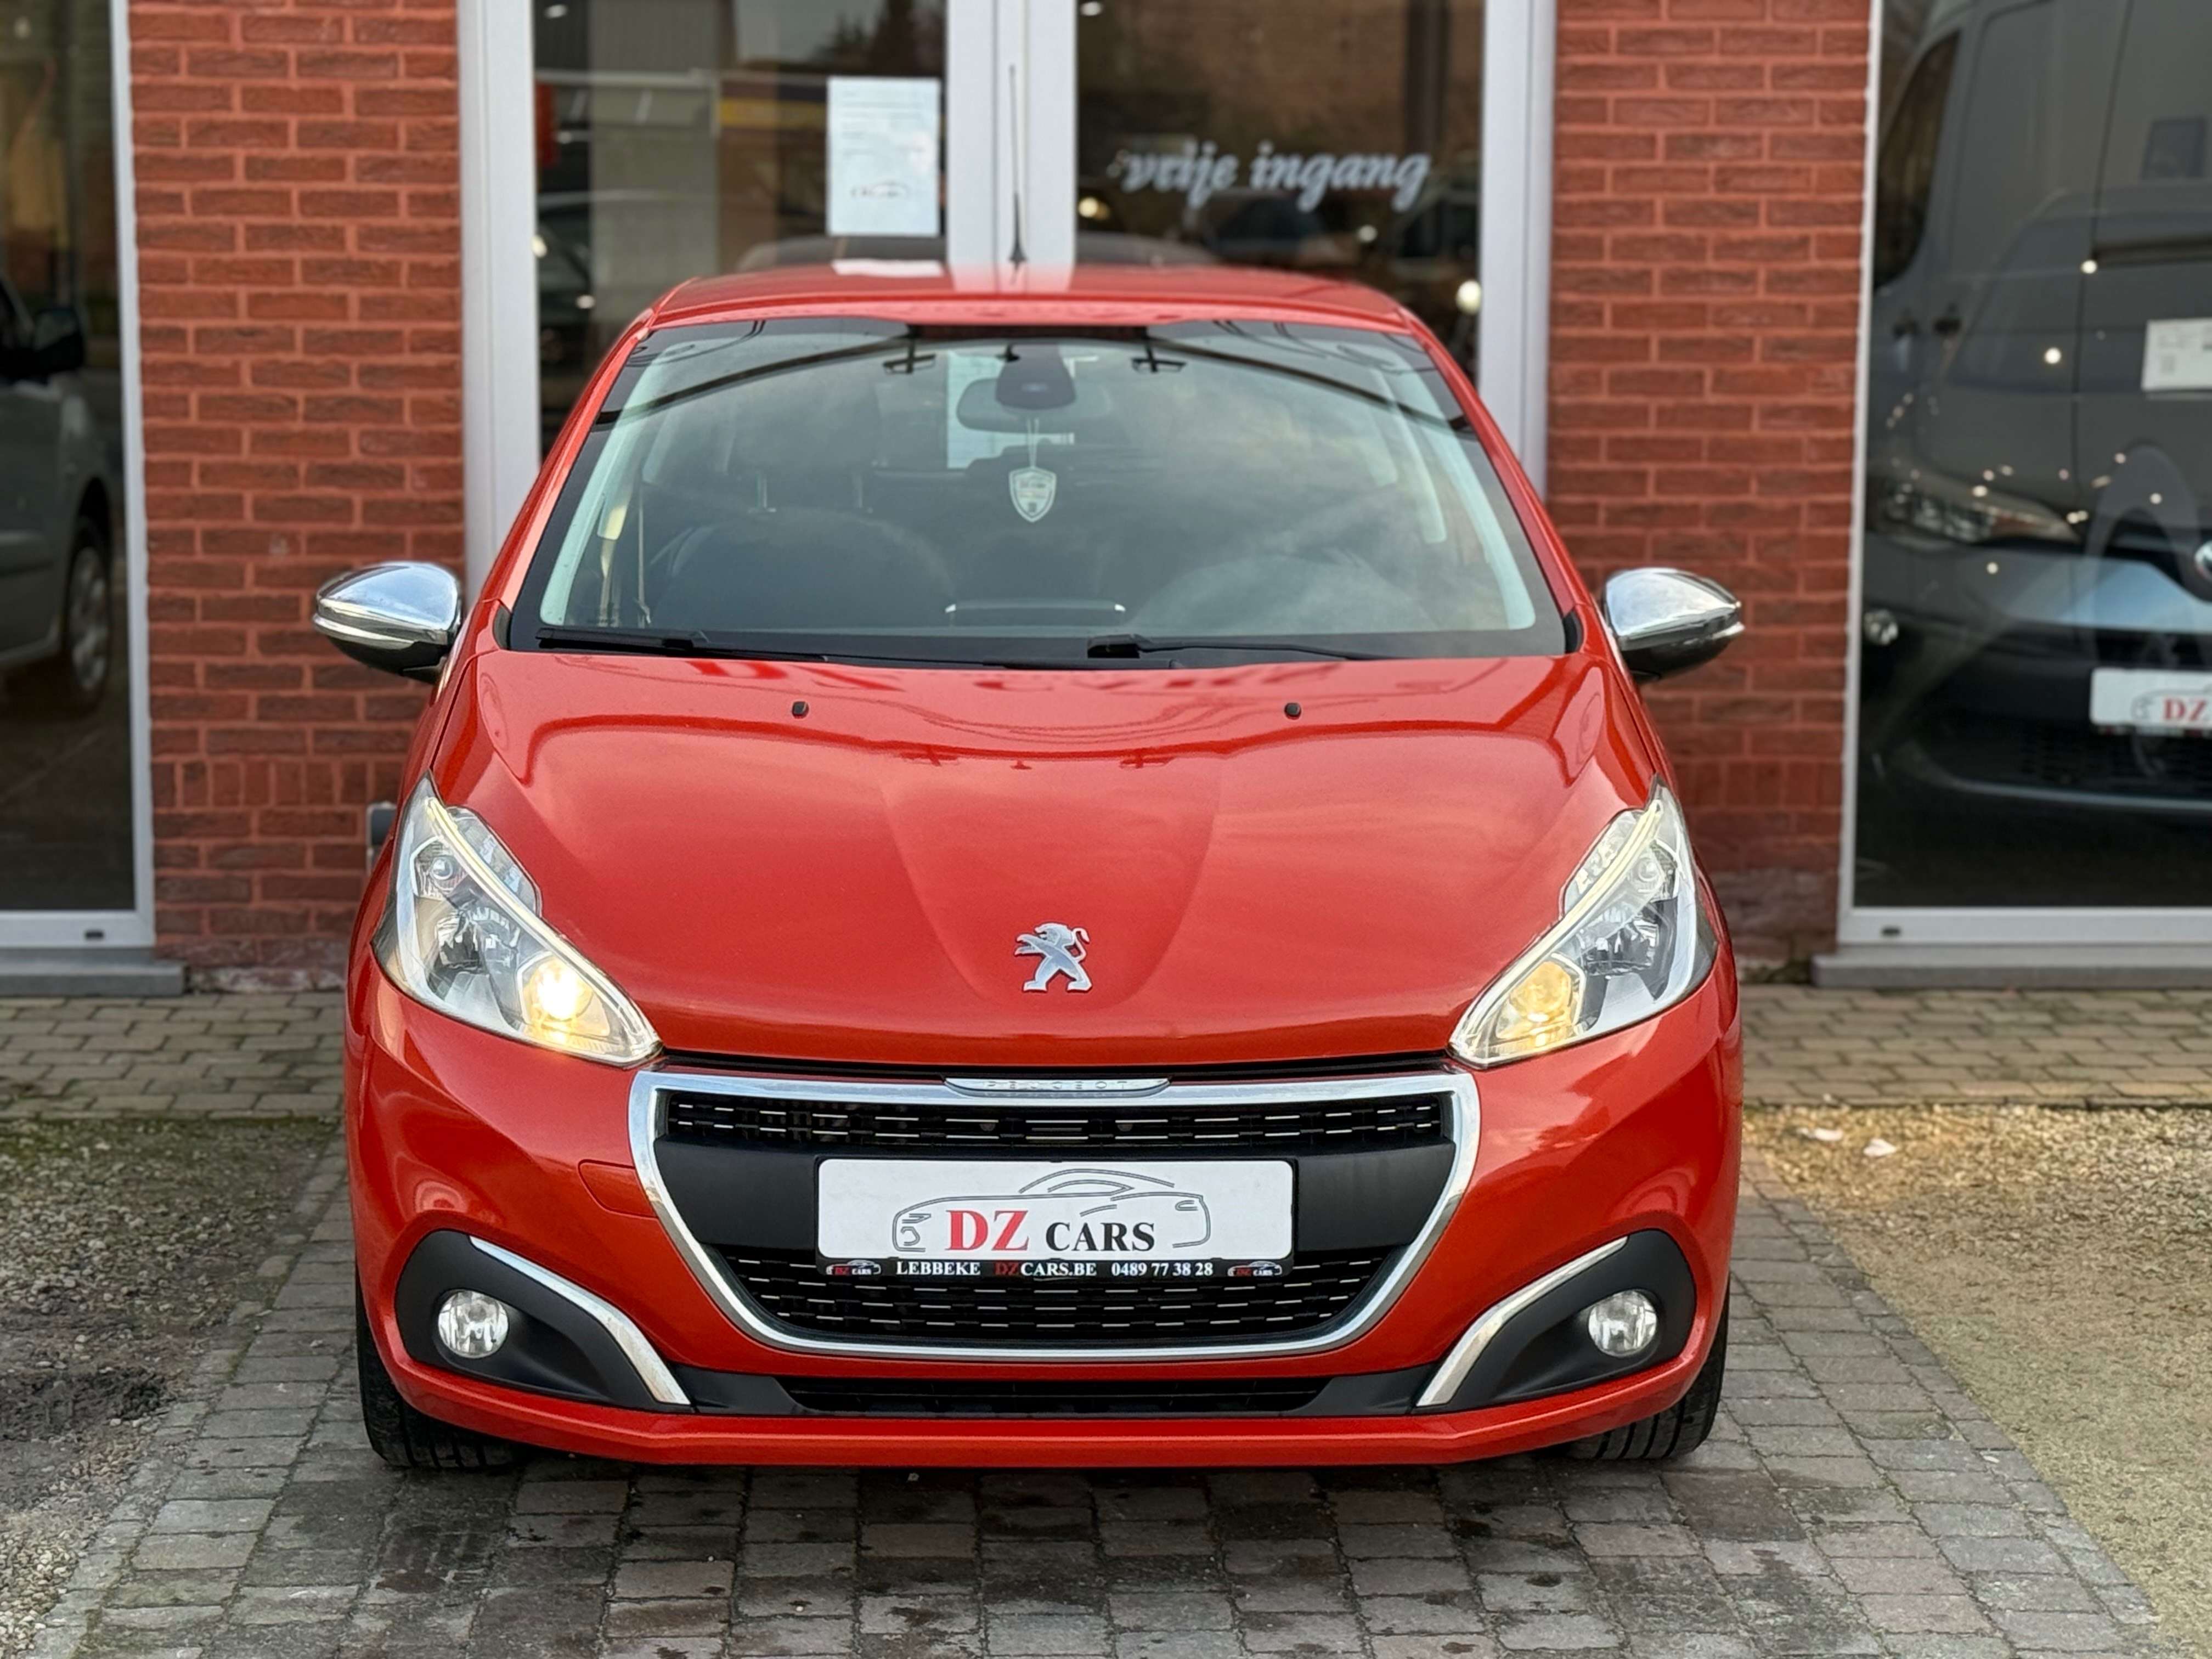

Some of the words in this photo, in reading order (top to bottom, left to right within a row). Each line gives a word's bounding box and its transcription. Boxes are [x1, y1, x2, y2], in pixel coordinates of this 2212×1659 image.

[1121, 138, 1239, 209] vrije
[1249, 140, 1432, 212] ingang
[2163, 698, 2207, 721] DZ
[945, 1210, 1030, 1251] DZ
[1046, 1222, 1155, 1251] CARS
[896, 1261, 981, 1276] LEBBEKE
[994, 1262, 1097, 1276] DZCARS.BE
[1111, 1262, 1148, 1276] 0489
[1151, 1262, 1169, 1276] 77
[1172, 1262, 1192, 1276] 38
[1195, 1262, 1214, 1276] 28
